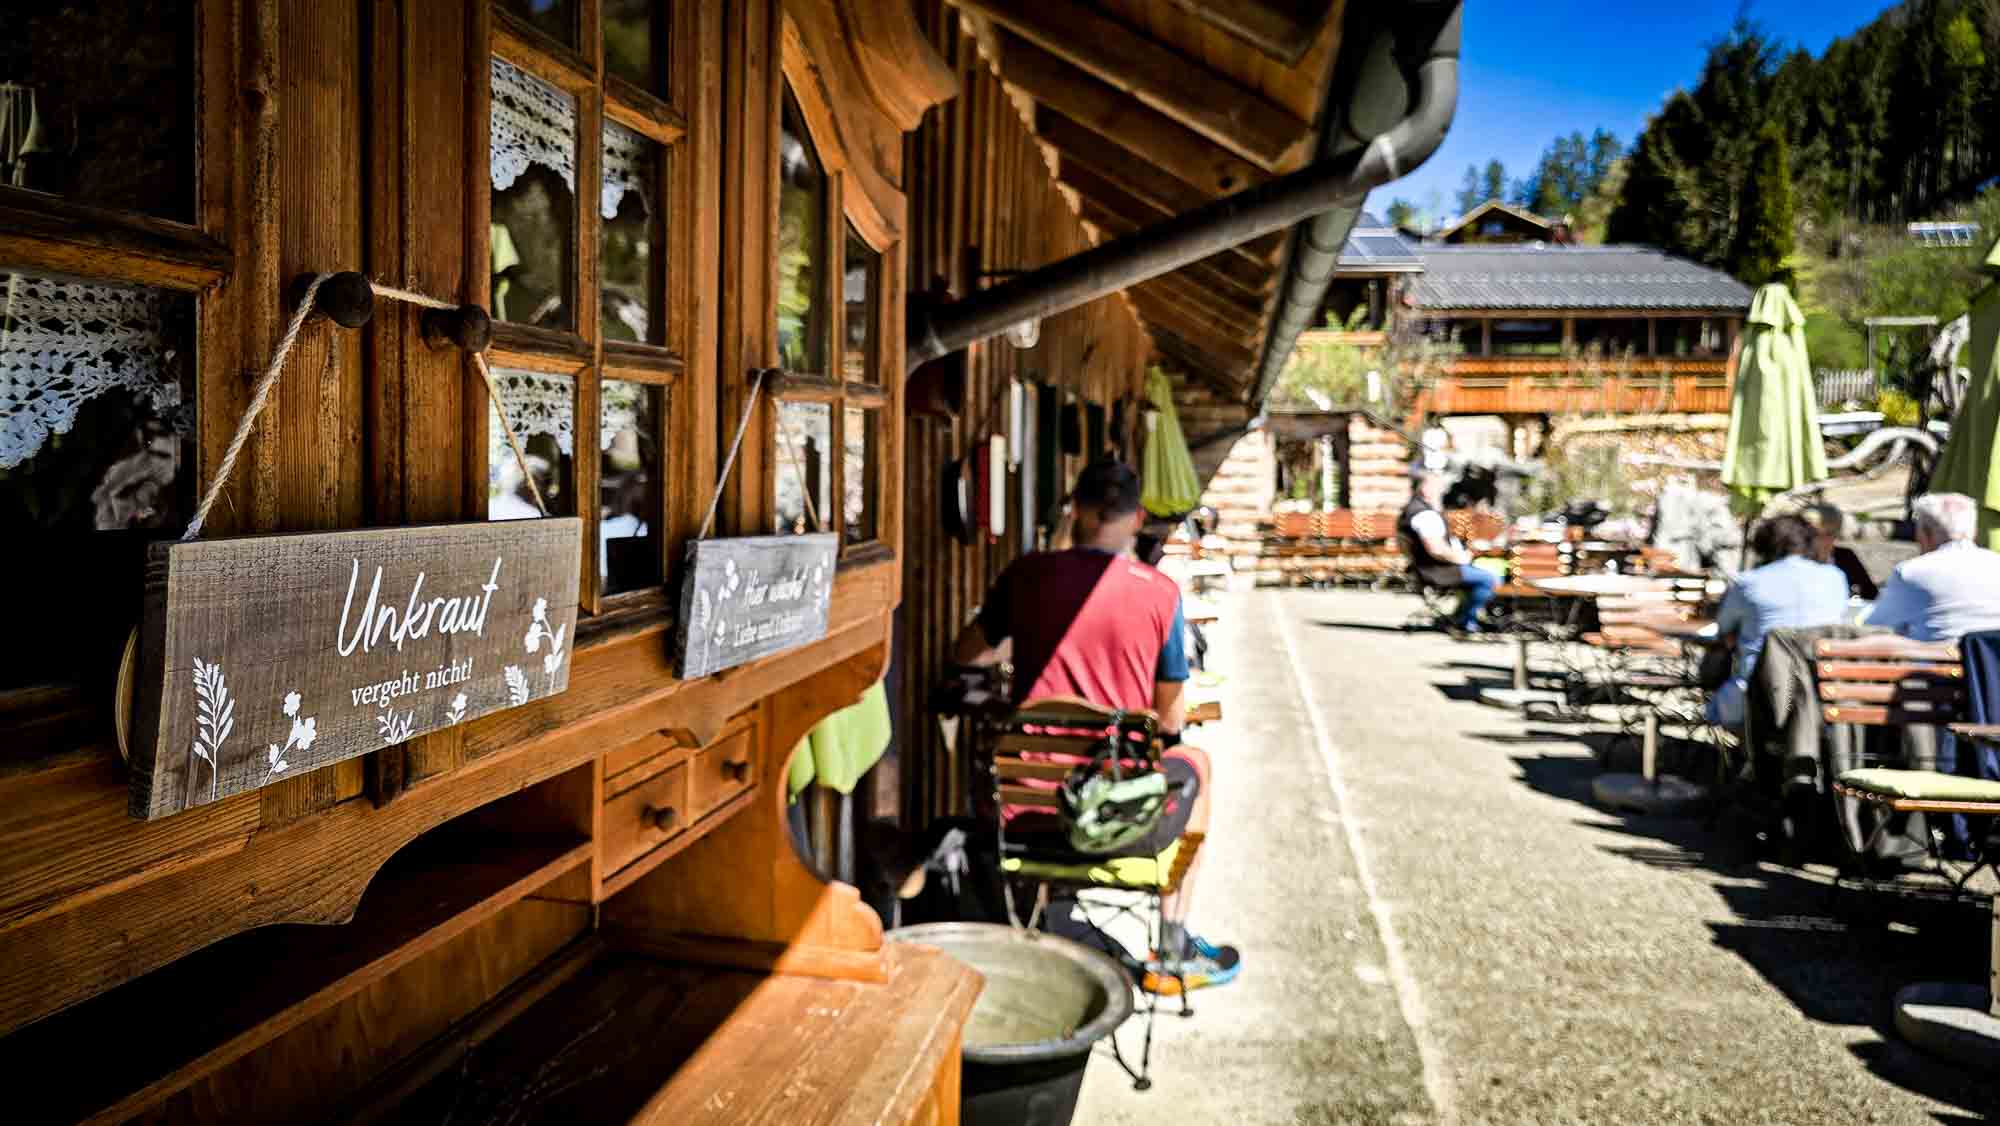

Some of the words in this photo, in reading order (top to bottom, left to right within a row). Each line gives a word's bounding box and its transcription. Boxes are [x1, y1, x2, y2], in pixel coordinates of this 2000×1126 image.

[337, 556, 502, 657] Unkraut
[351, 670, 420, 708] vergeht
[425, 656, 474, 689] nicht!
